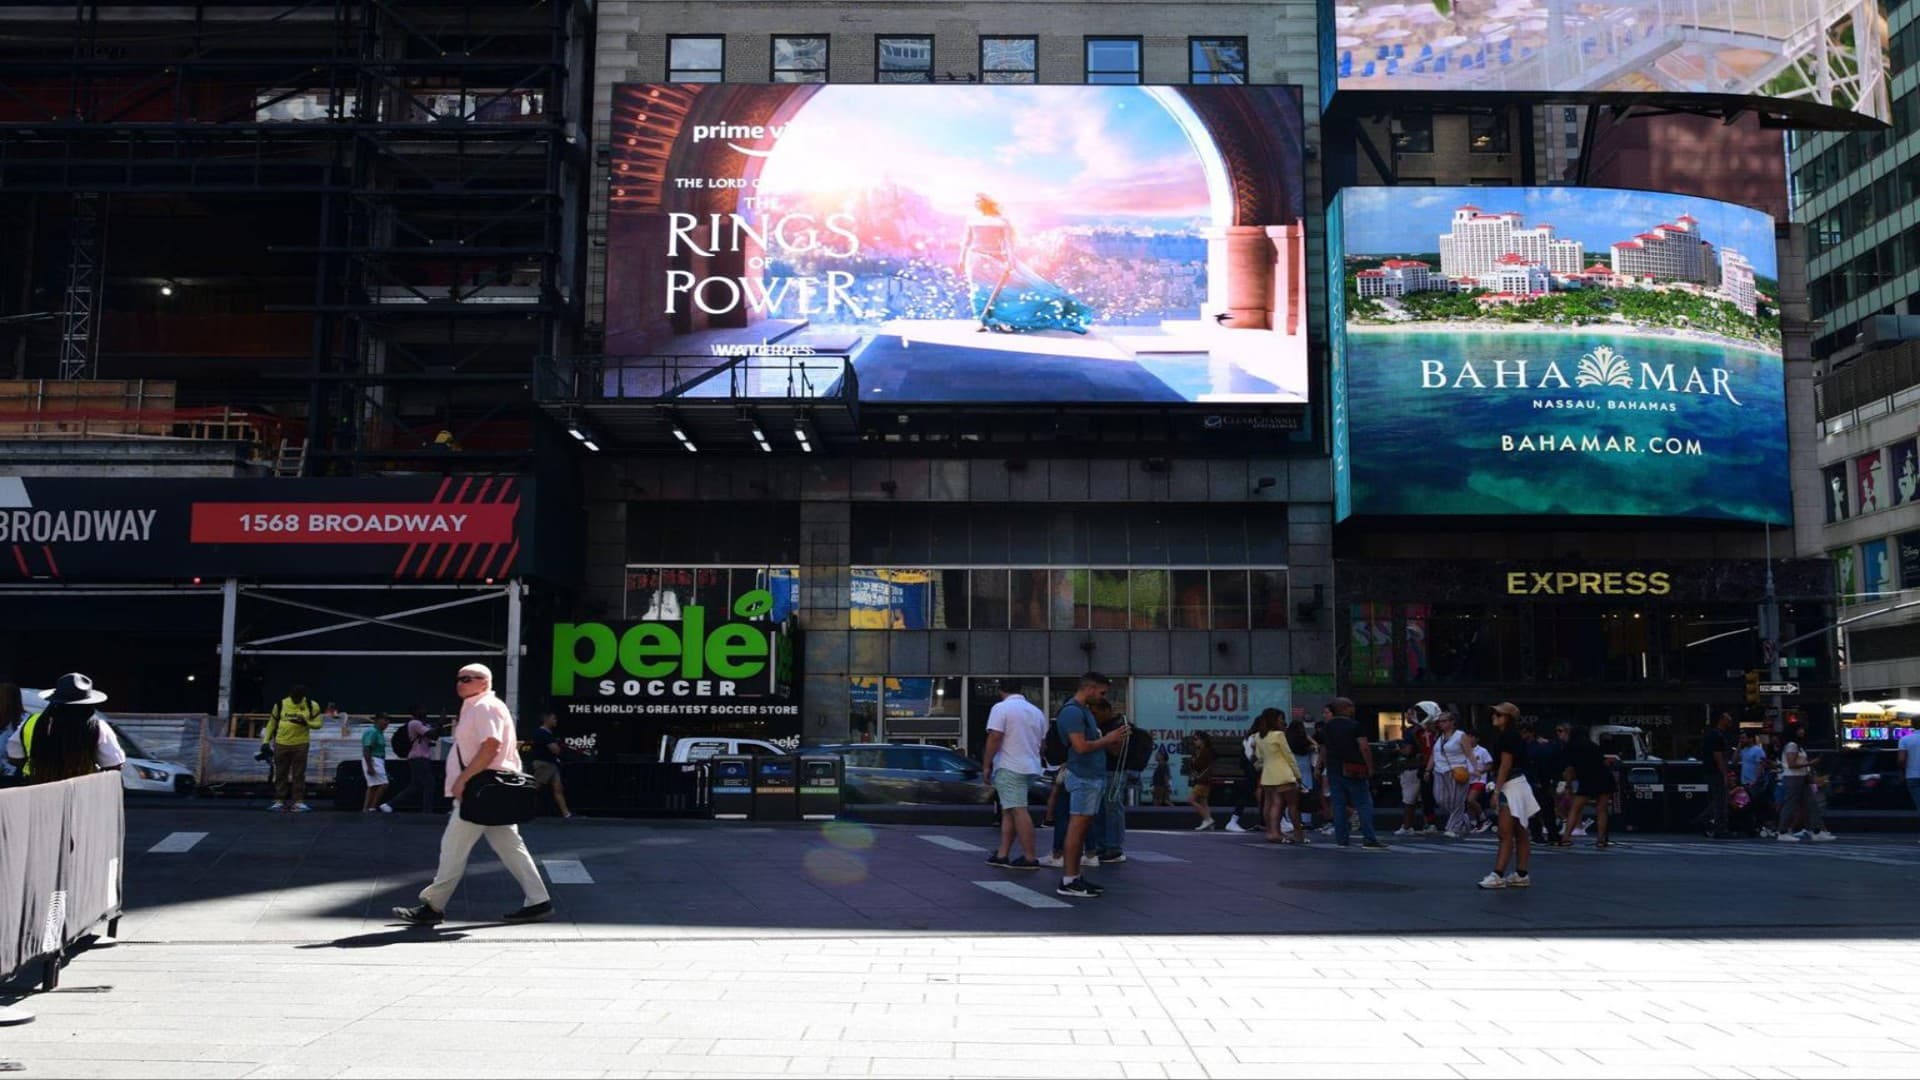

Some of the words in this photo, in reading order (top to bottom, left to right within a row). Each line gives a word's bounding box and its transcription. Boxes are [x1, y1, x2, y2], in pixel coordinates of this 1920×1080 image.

[692, 121, 765, 143] prime
[675, 178, 703, 188] THE
[708, 178, 747, 188] LORD
[667, 212, 859, 258] RINGS
[749, 257, 774, 270] OF
[664, 270, 864, 318] POWER
[1420, 359, 1570, 389] BAHA
[1640, 361, 1743, 407] MAR
[1532, 399, 1600, 410] NASSAU,
[1607, 400, 1678, 412] BAHAMAS
[1500, 435, 1704, 457] BAHAMAR.COM
[239, 514, 299, 532] 1568
[308, 514, 468, 532] BROADWAY
[1506, 571, 1672, 595] EXPRESS
[551, 588, 774, 697] pelé
[598, 679, 738, 697] SOCCER
[1173, 683, 1238, 712] 1560
[568, 704, 591, 714] THE
[593, 704, 645, 715] WORLD'S
[646, 704, 708, 716] GREATEST
[709, 705, 758, 716] SOCCER
[759, 705, 799, 717] STORE
[1150, 729, 1185, 740] ETAIL
[1152, 743, 1184, 754] PACE
